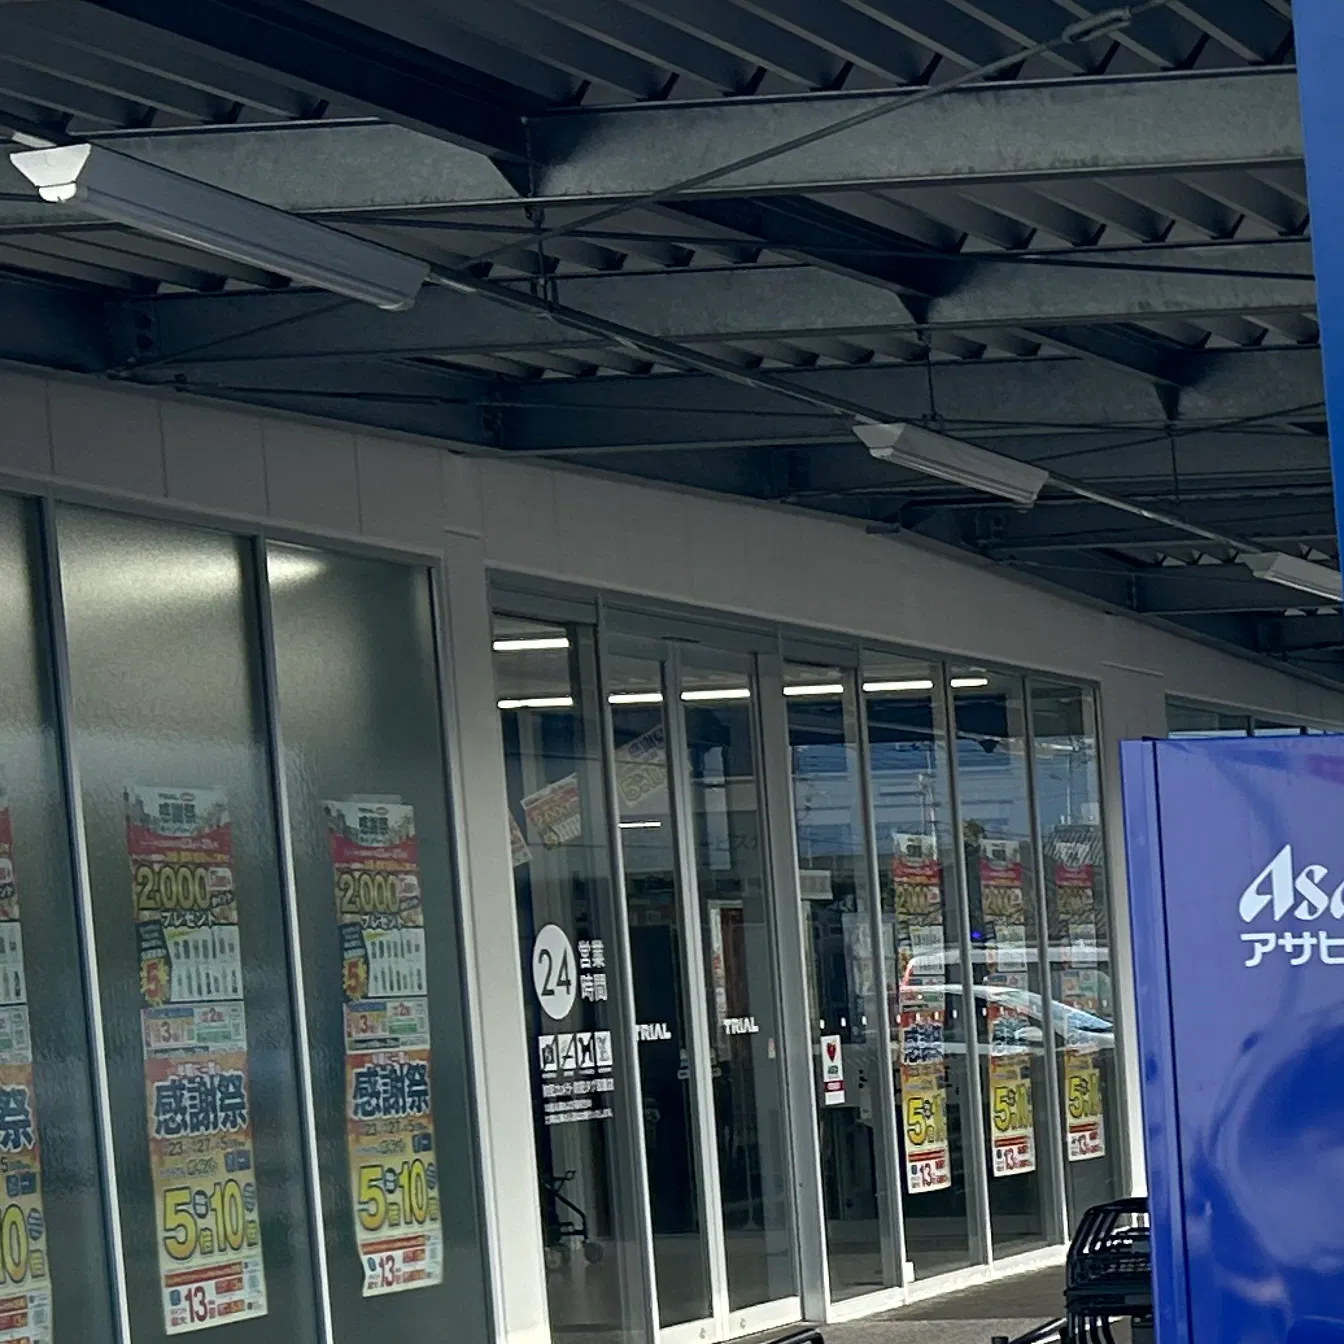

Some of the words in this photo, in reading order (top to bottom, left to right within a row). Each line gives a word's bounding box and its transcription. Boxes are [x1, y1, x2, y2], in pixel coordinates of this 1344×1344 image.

[538, 948, 571, 996] 24
[635, 1022, 671, 1042] TRIAL
[724, 1016, 759, 1035] TRIAL
[153, 1070, 249, 1138] 感謝祭
[353, 1060, 431, 1119] 感謝祭
